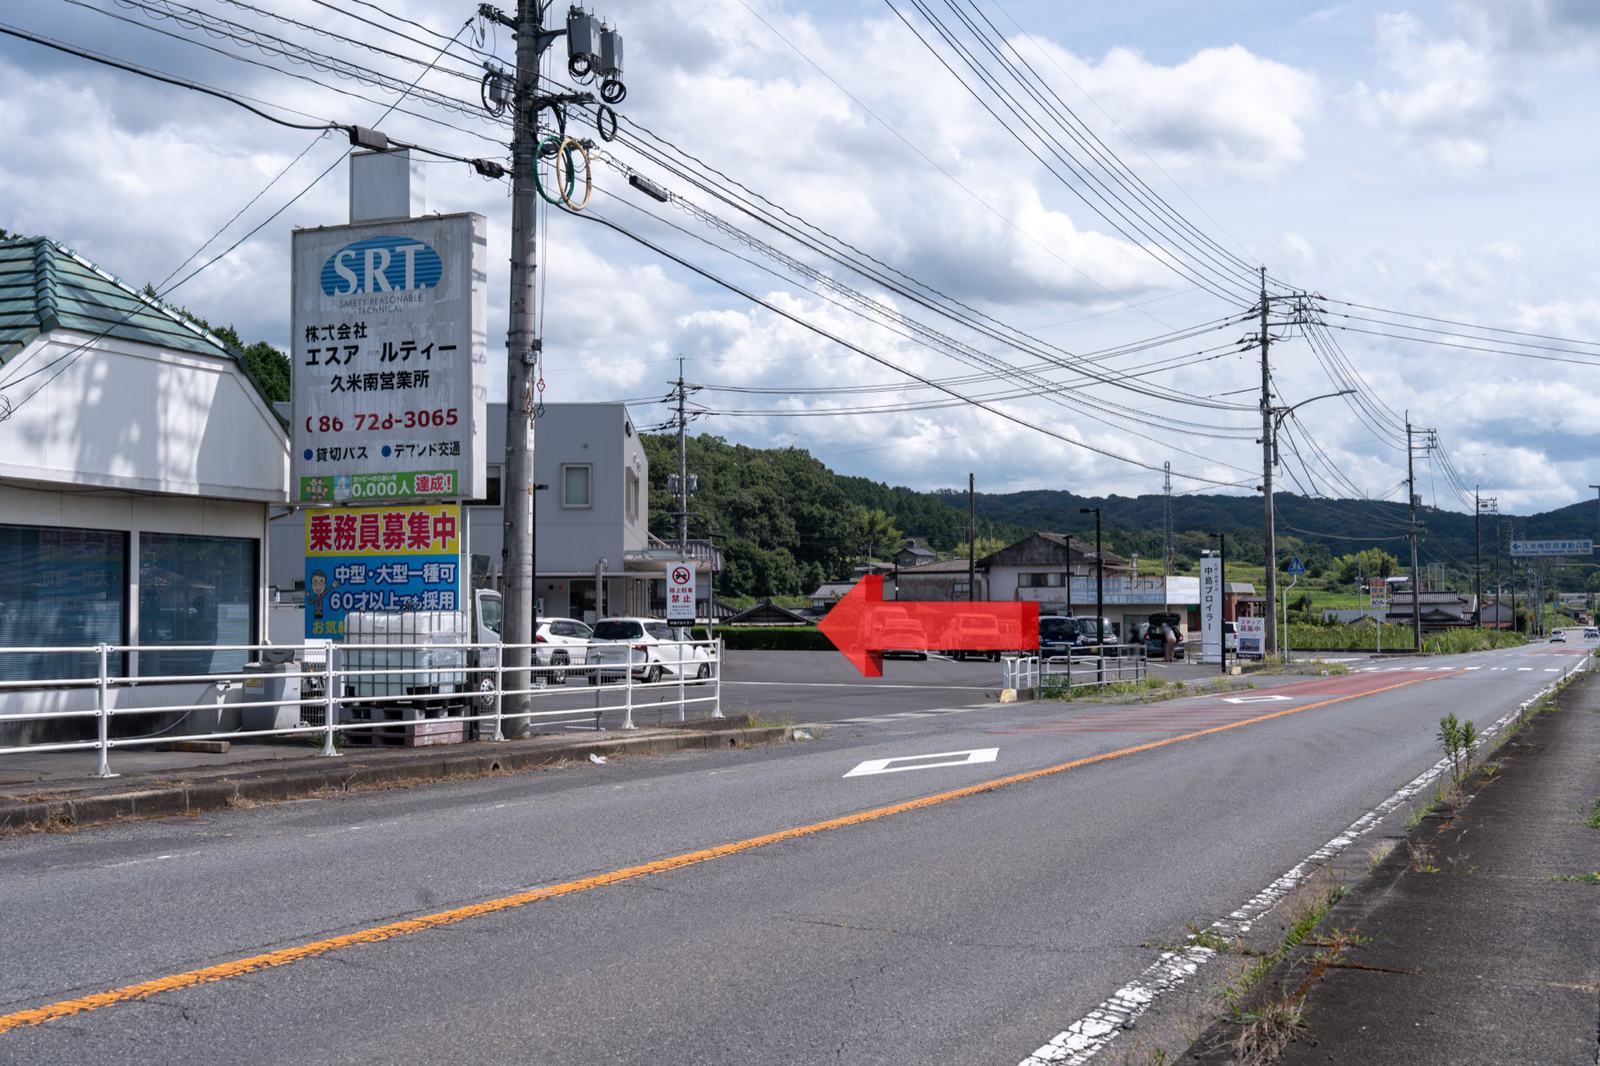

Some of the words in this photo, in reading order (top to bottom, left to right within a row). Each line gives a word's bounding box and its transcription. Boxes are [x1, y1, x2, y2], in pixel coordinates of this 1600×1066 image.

[330, 369, 429, 393] 久米南営業所
[316, 446, 368, 463] 貸切バス
[310, 511, 456, 551] 乗務員募集中
[335, 563, 456, 585] 中型・大型一種可
[330, 591, 455, 611] 60才以上でも採用
